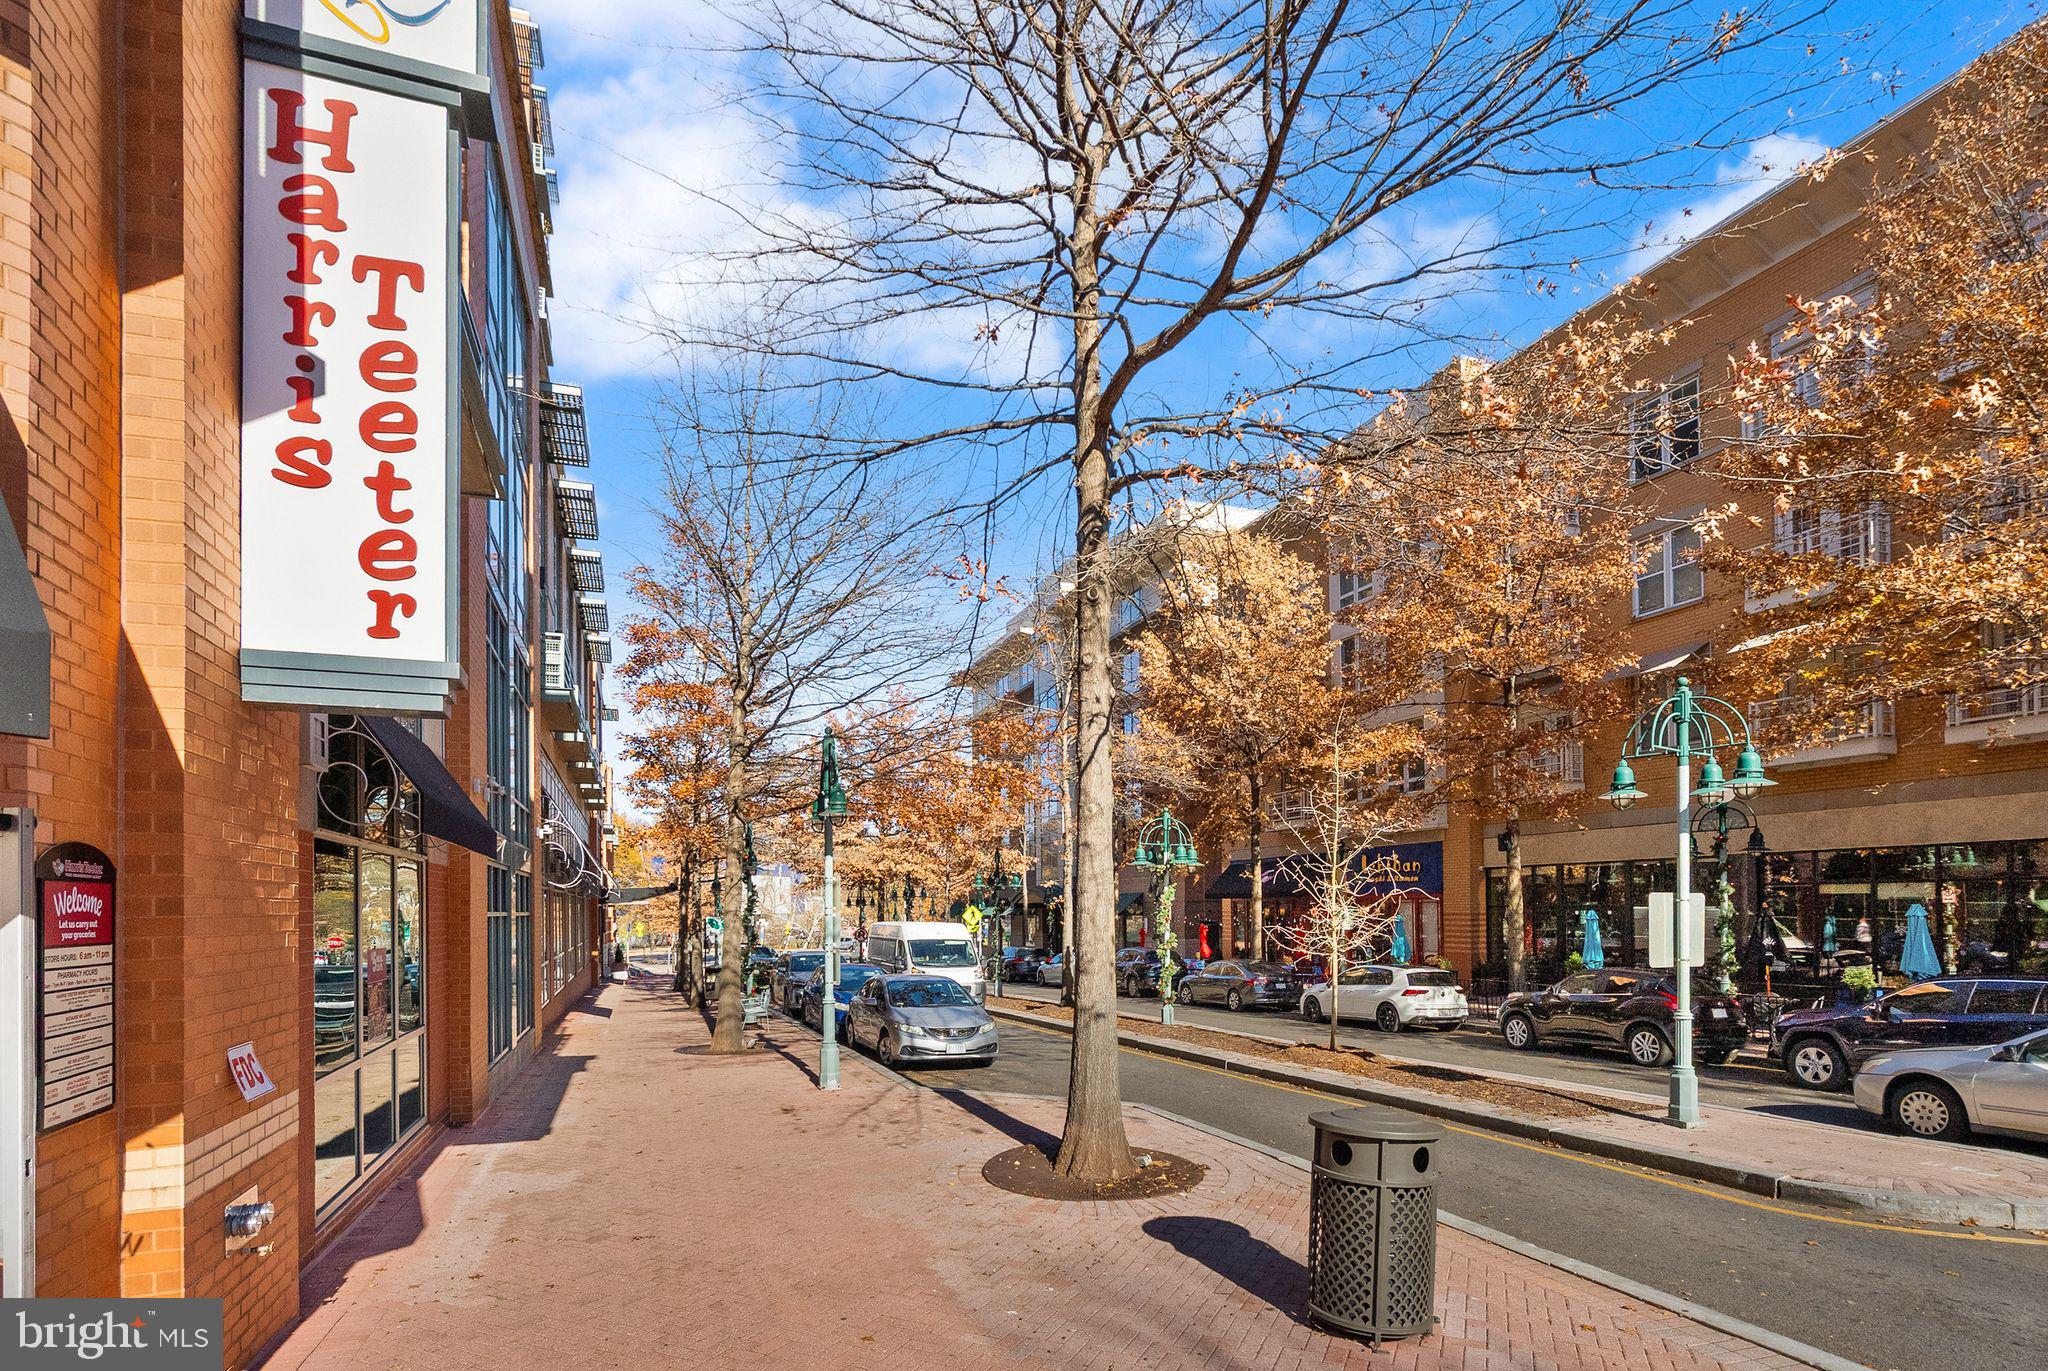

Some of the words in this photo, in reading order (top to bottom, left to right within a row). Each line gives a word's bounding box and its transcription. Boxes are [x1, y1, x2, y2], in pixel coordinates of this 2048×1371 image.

[267, 88, 358, 489] Harris
[352, 254, 424, 639] Teeter
[53, 886, 102, 916] Welcome
[58, 920, 68, 928] Let
[62, 932, 73, 941] your
[74, 930, 96, 940] groceries
[45, 955, 60, 963] STORE
[61, 953, 78, 962] HOURS:
[57, 971, 82, 979] PHARMACY
[232, 1053, 264, 1091] FDC
